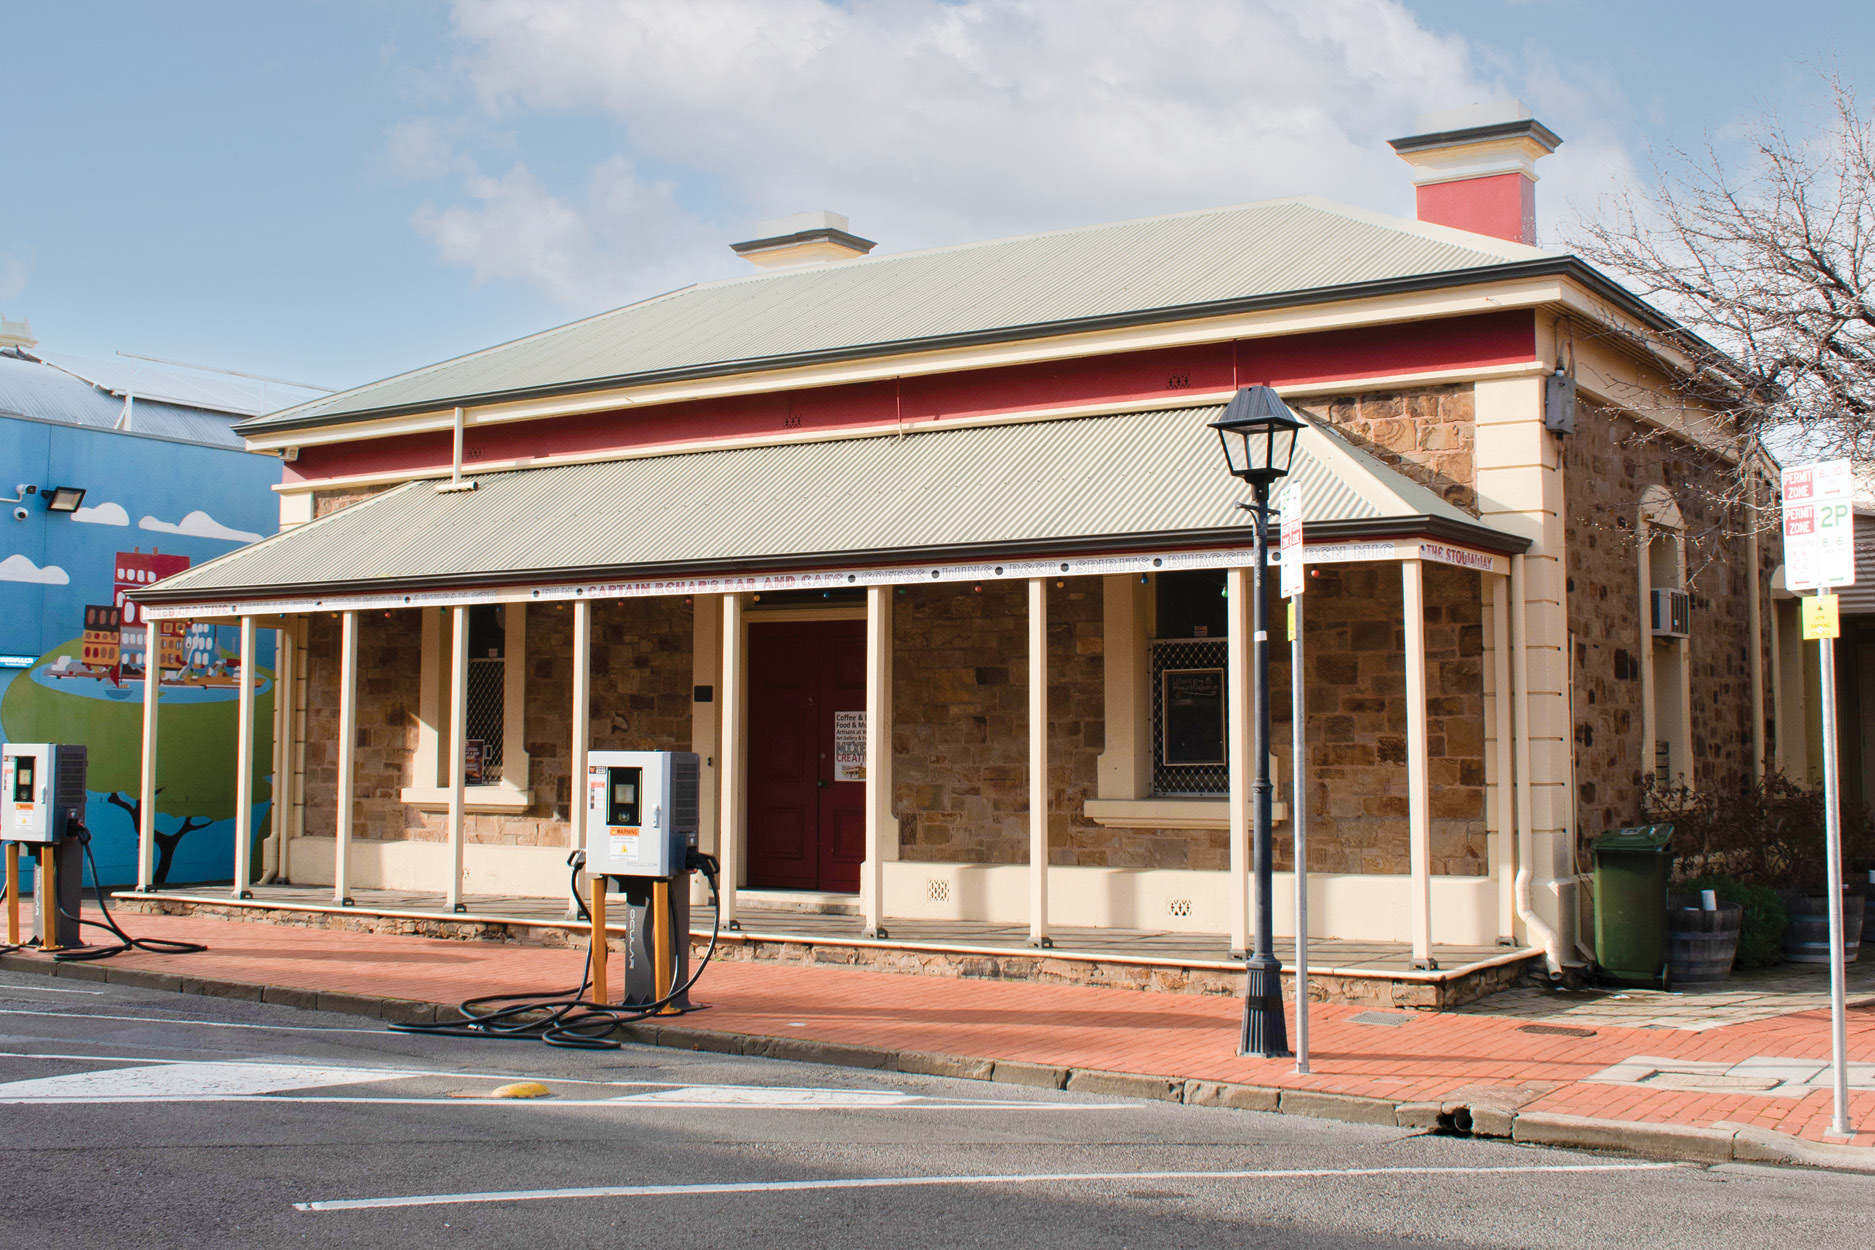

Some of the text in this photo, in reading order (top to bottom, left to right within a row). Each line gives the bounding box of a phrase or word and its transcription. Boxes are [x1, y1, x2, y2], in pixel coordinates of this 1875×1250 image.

[1784, 471, 1813, 485] PERMIT
[1788, 485, 1810, 498] ZONE
[1785, 506, 1814, 520] PERMIT
[1820, 504, 1848, 528] 2P
[1789, 521, 1811, 534] ZONE
[1302, 543, 1395, 562] PEN MIC
[1426, 544, 1443, 558] THE
[1075, 556, 1150, 574] SPIRITS
[1168, 550, 1255, 569] BURGER
[861, 569, 926, 585] COFFEE
[943, 564, 993, 581] WINE
[1009, 561, 1057, 578] BEER
[588, 582, 651, 597] CAPTAIN
[724, 577, 757, 591] BAR
[762, 575, 796, 589] AND
[801, 573, 844, 587] CAFE
[616, 828, 639, 836] WARNING
